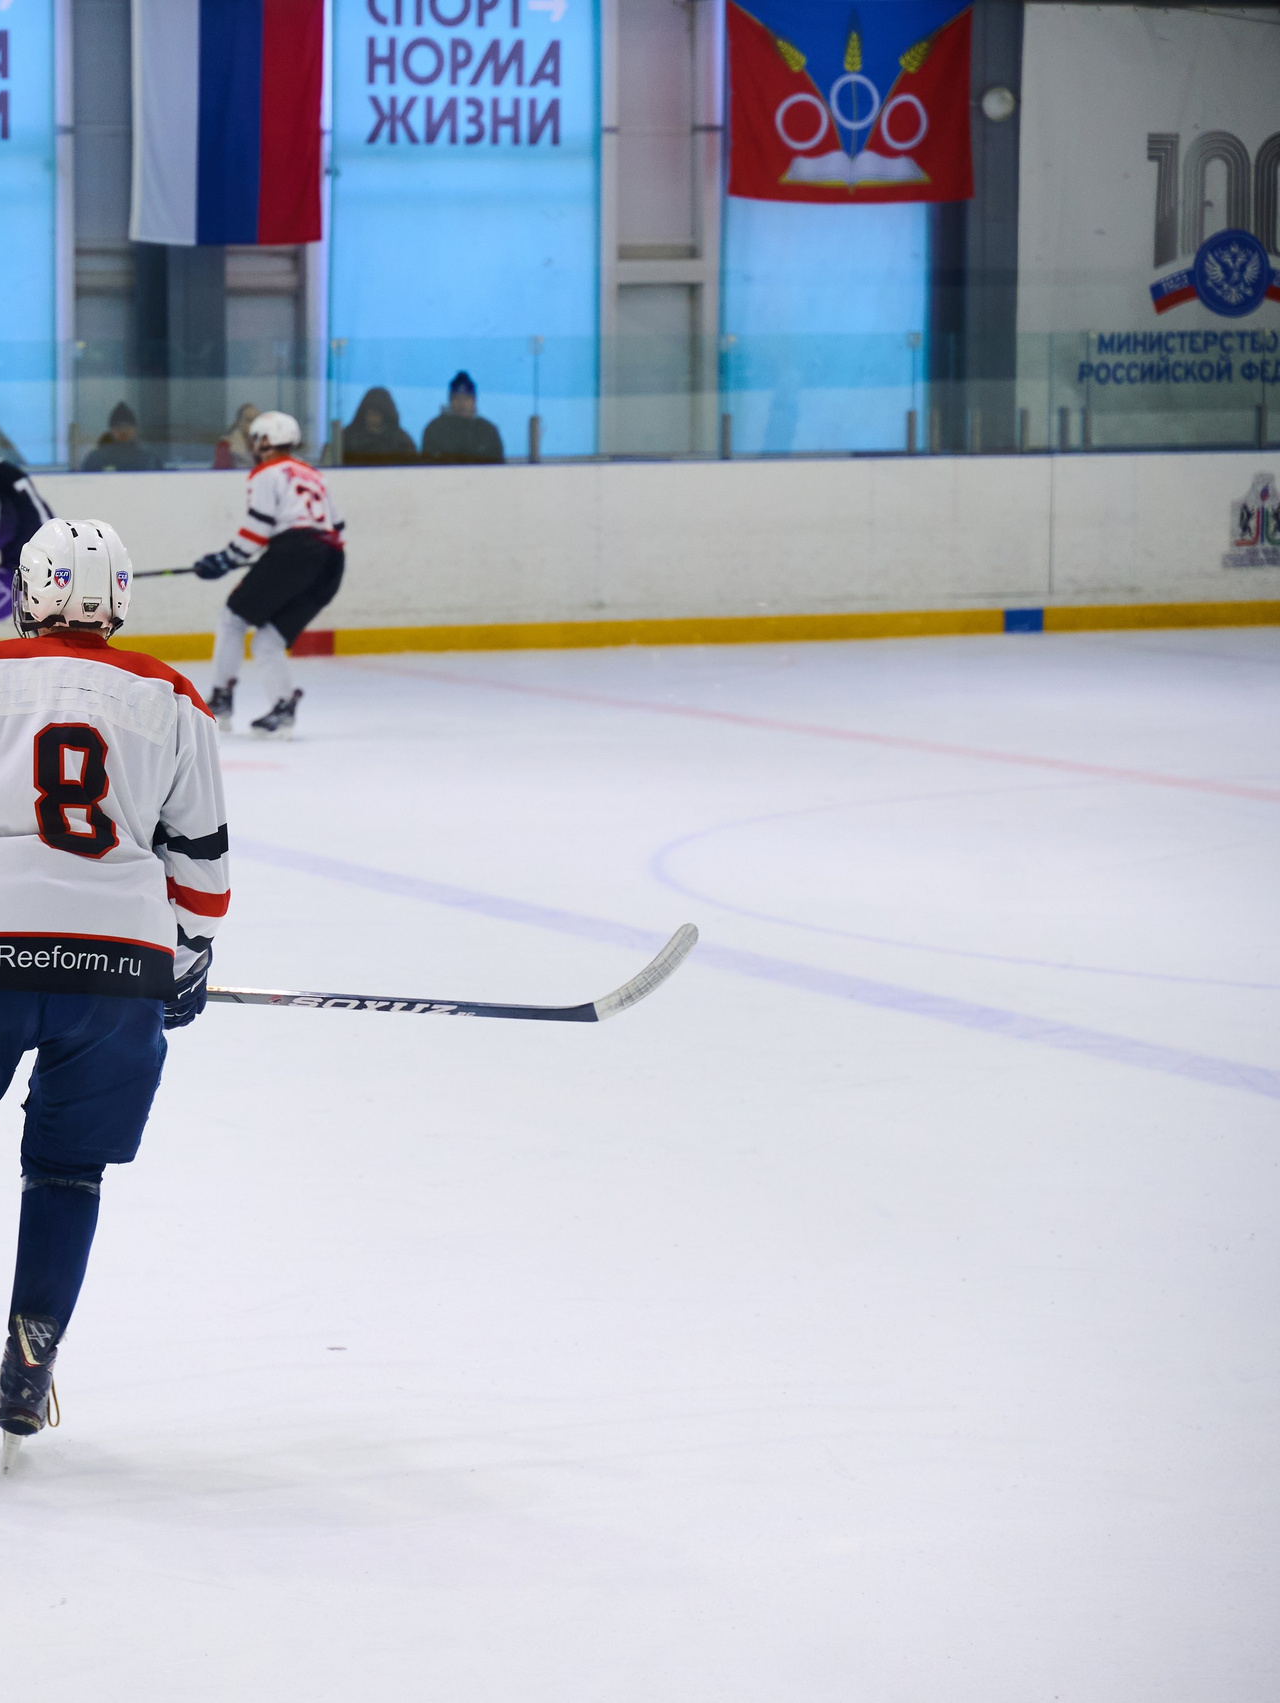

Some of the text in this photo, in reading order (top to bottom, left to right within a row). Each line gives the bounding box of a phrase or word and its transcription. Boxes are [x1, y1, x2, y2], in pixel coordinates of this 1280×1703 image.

[366, 36, 561, 87] НОРМА
[366, 95, 561, 146] ЖИЗНИ
[1077, 354, 1233, 384] РОССИЙСКОЙ
[33, 722, 120, 859] 8
